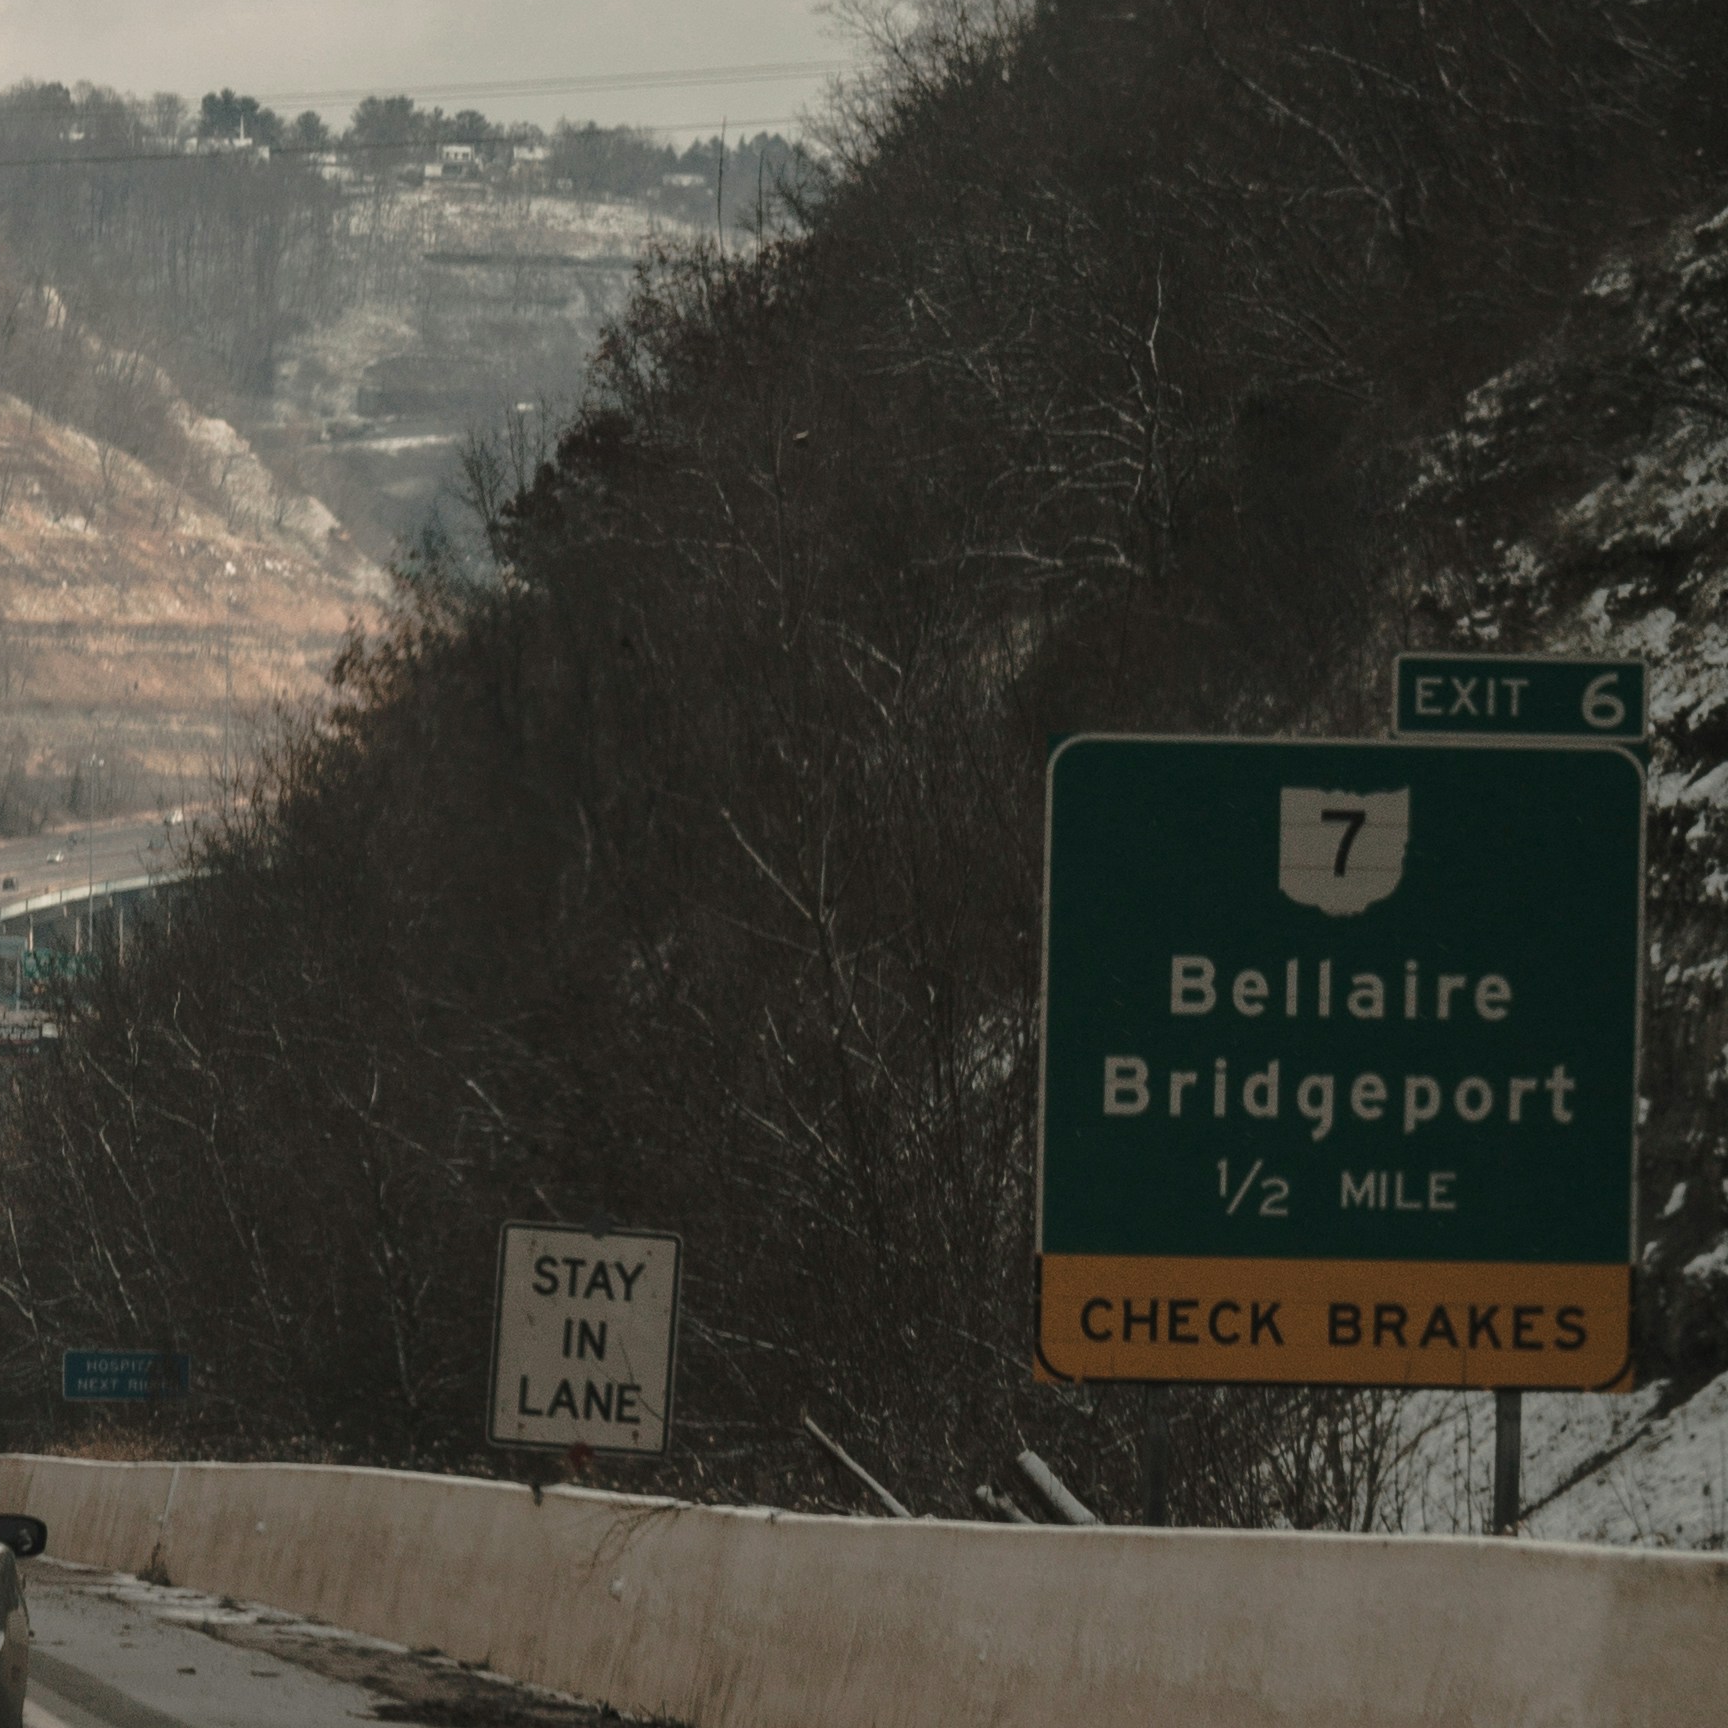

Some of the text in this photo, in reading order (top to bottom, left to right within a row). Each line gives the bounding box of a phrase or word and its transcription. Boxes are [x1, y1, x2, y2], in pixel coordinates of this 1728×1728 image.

[1414, 672, 1626, 730] EXIT 6
[1320, 809, 1367, 878] 7
[1170, 955, 1513, 1021] Bellaire
[1102, 1055, 1576, 1142] Bridgeport
[1340, 1170, 1457, 1211] MILE
[531, 1254, 646, 1302] STAY
[562, 1317, 607, 1362] IN
[1079, 1297, 1588, 1351] CHECK BRAKES
[77, 1377, 120, 1391] NEXT
[518, 1374, 642, 1424] LANE
